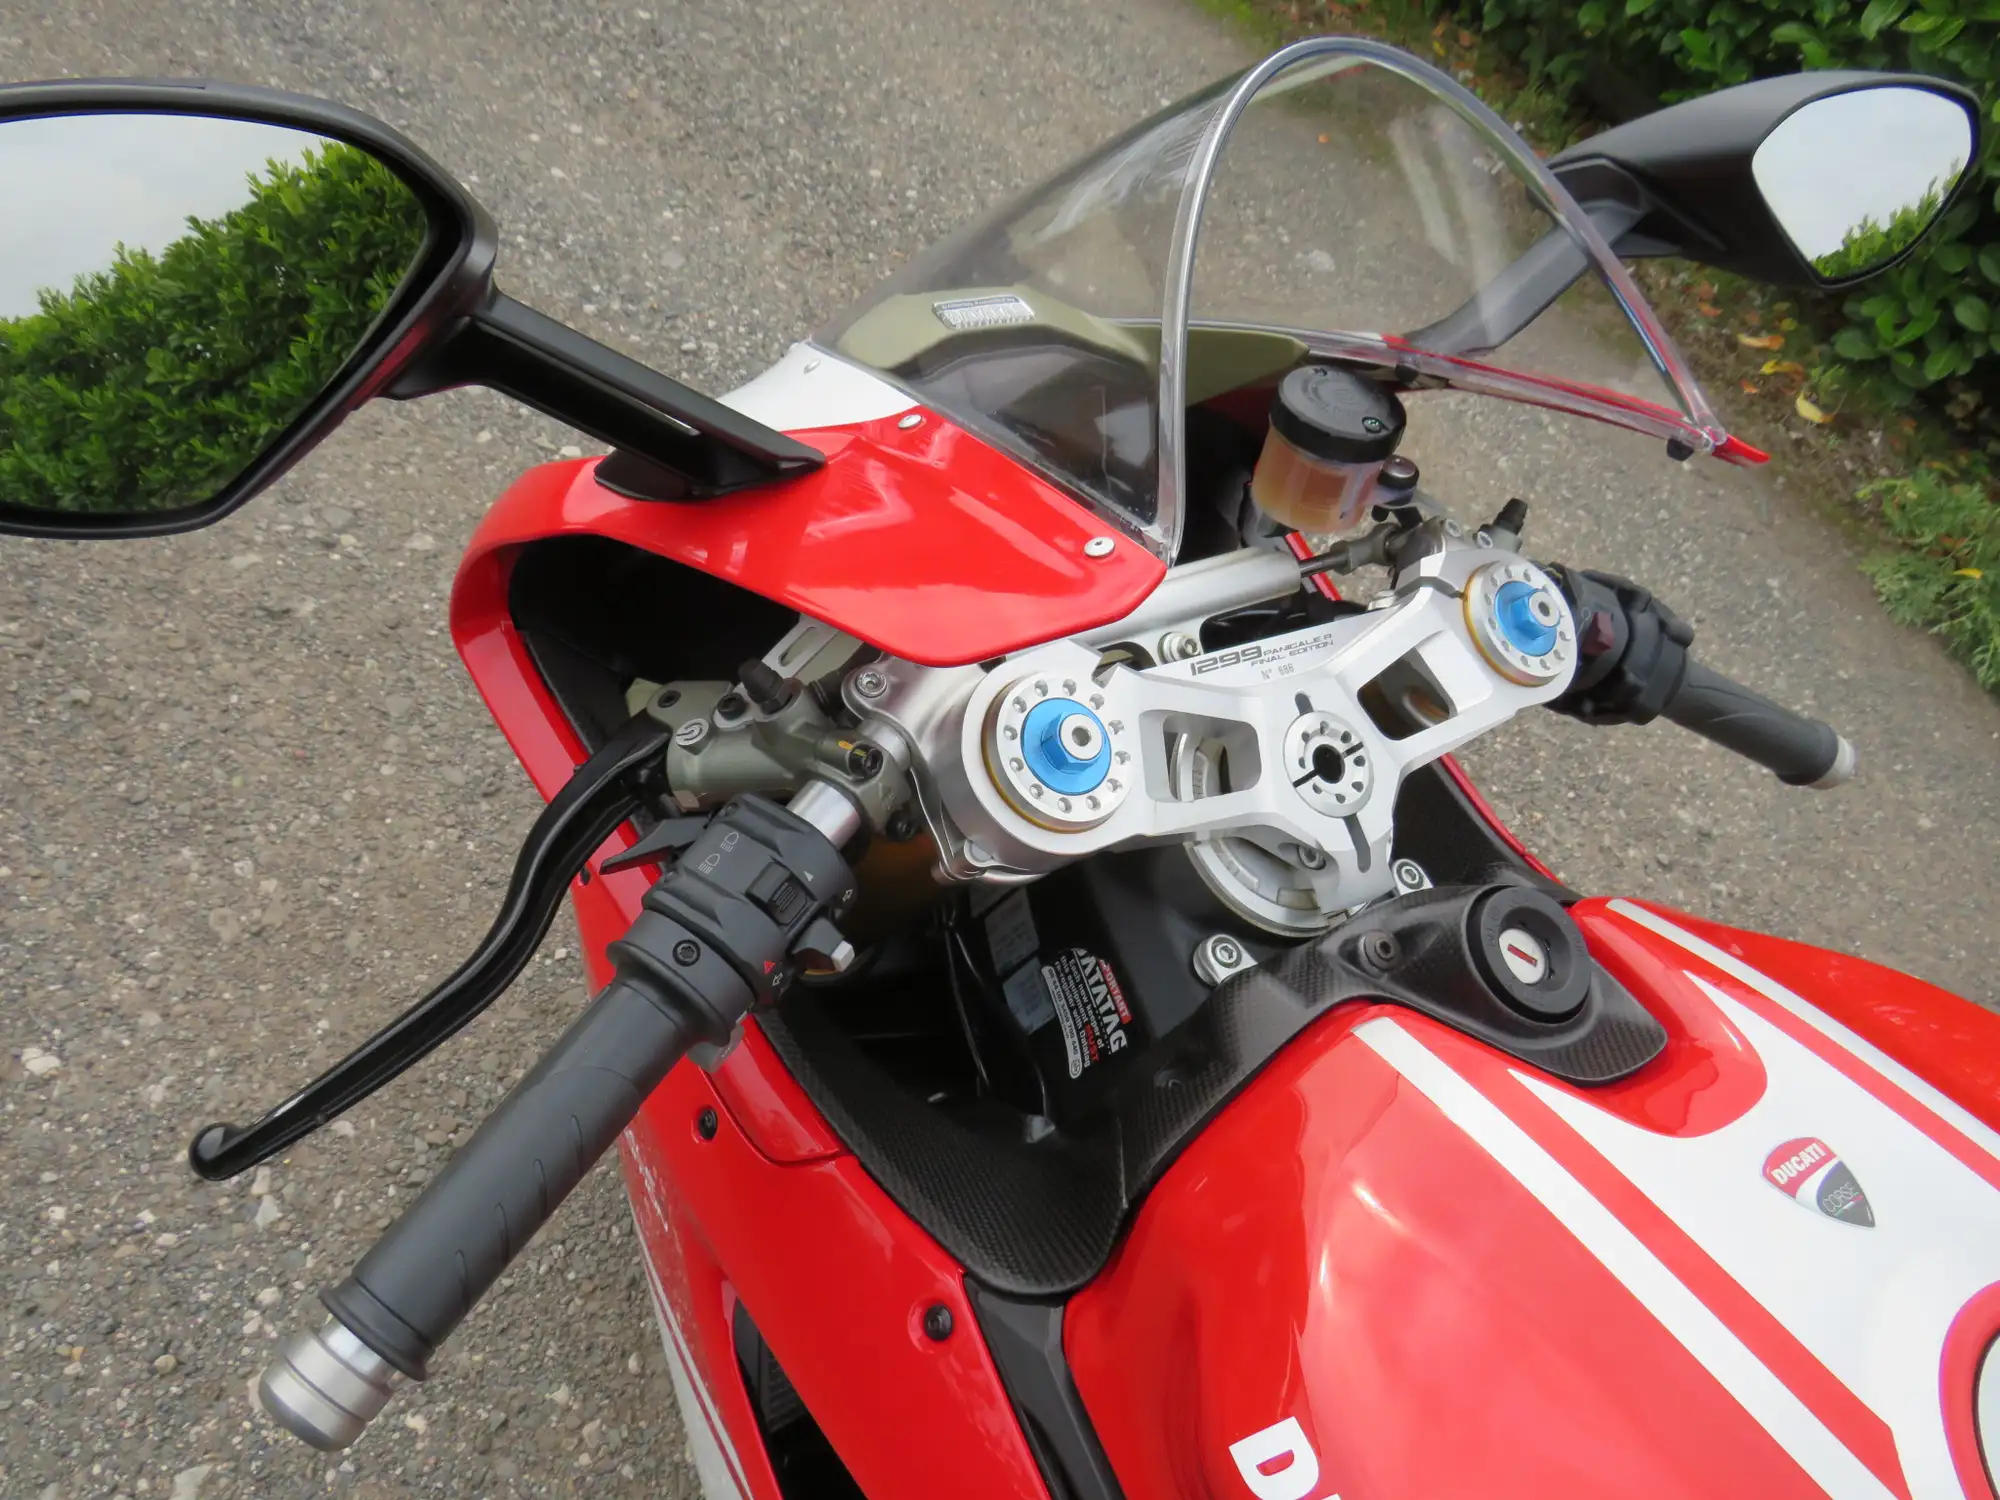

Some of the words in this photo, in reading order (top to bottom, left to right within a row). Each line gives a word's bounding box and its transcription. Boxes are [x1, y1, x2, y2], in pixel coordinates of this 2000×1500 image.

[1190, 645, 1262, 676] 1299
[1251, 654, 1285, 667] FINAL
[1288, 640, 1334, 656] EDITION
[1060, 955, 1069, 973] this
[1067, 974, 1088, 1022] equipment
[1067, 958, 1080, 981] Each
[1077, 983, 1088, 1002] new
[1085, 1004, 1099, 1036] keeper
[1095, 1037, 1104, 1048] of
[1099, 958, 1128, 1017] PORTANT
[1072, 1008, 1082, 1029] with
[1771, 1142, 1826, 1185] DUCATI
[1822, 1181, 1854, 1213] CORSE
[1228, 1415, 1341, 1500] D
